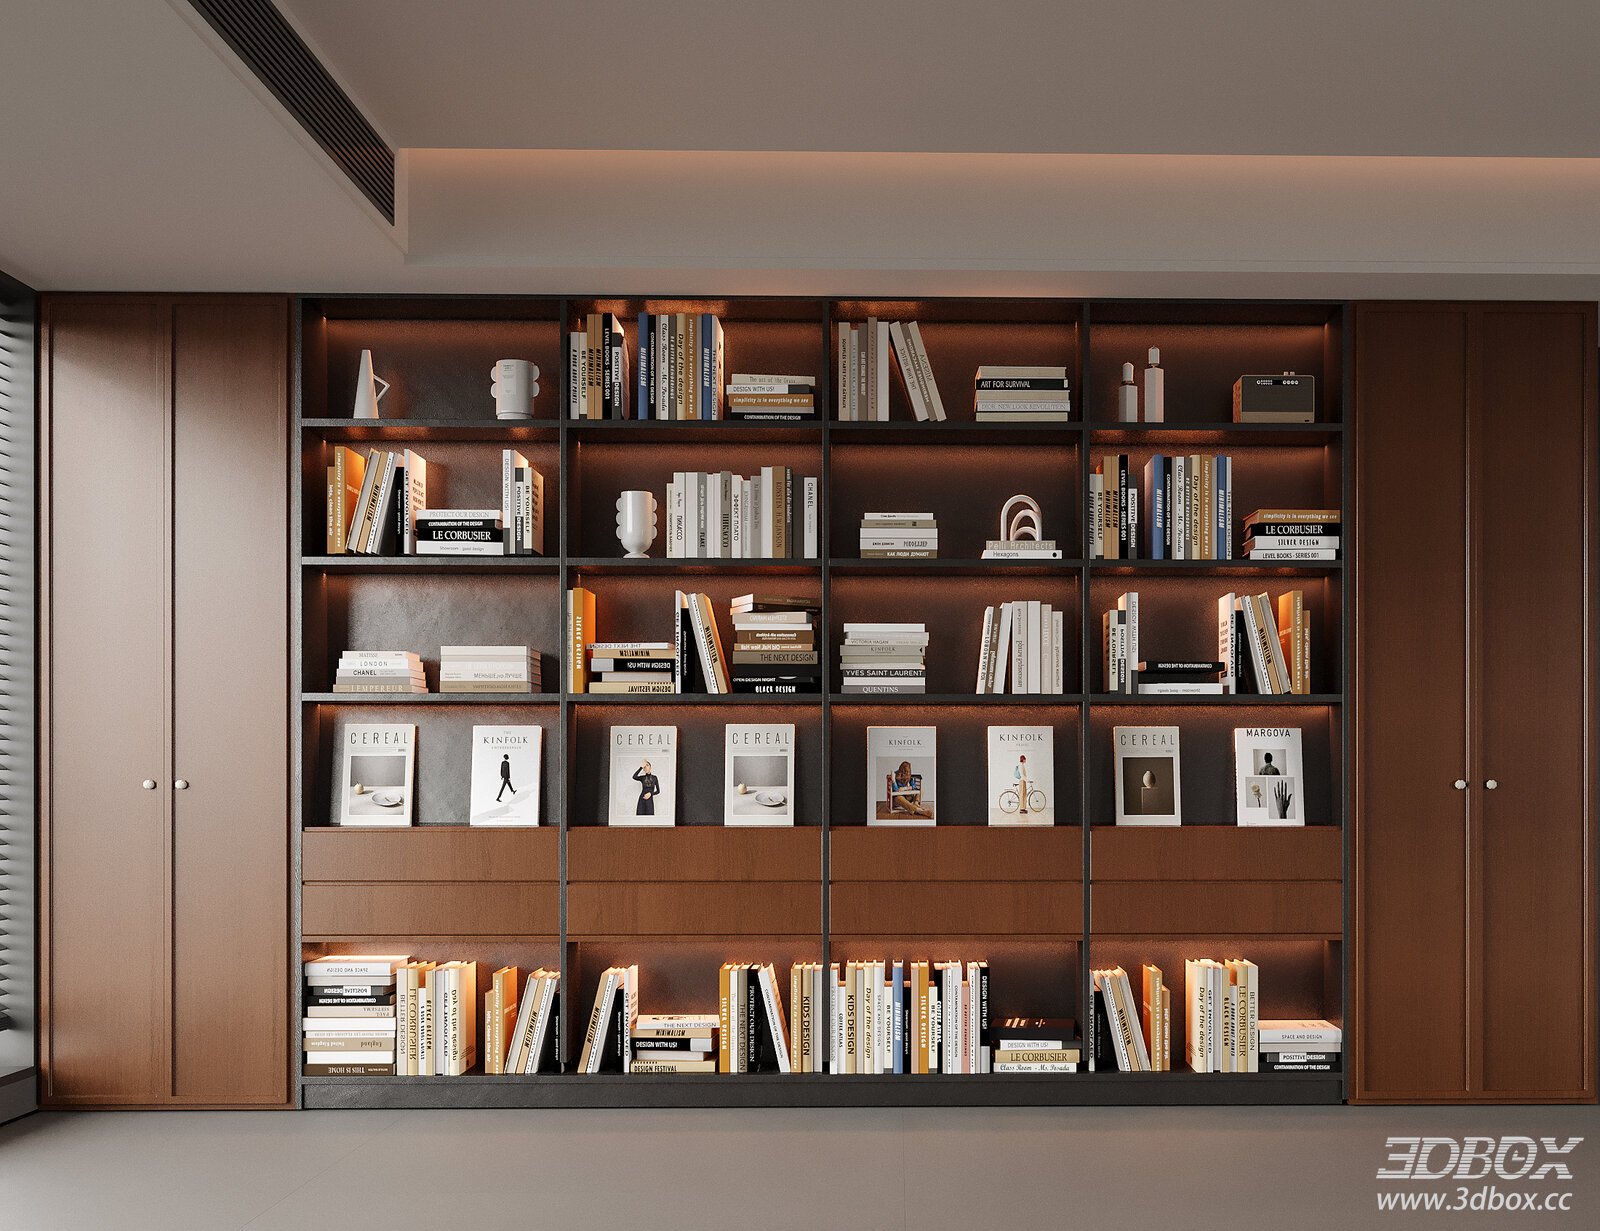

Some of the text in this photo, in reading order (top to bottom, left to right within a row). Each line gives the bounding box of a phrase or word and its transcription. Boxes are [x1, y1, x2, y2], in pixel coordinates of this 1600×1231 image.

[581, 350, 586, 359] BE
[677, 351, 684, 360] of
[525, 485, 530, 494] BE
[1192, 493, 1199, 502] of
[366, 484, 380, 522] MINIMALISM
[433, 530, 491, 540] LE CORBUSIER
[1265, 525, 1323, 535] LE CORBUSIER
[732, 732, 789, 744] CEREAL
[1246, 728, 1291, 738] MARGOVA
[350, 732, 408, 745] CEREAL
[483, 736, 528, 744] KINFOLK
[616, 733, 671, 745] CEREAL
[1120, 734, 1175, 746] CEREAL
[1239, 985, 1246, 998] LE
[865, 1005, 871, 1014] of
[886, 1005, 891, 1015] BE
[1198, 1004, 1205, 1013] of
[524, 1010, 538, 1048] MINIMALISM
[587, 1006, 600, 1044] MINIMALISM
[1010, 1053, 1067, 1062] LE CORBUSIER
